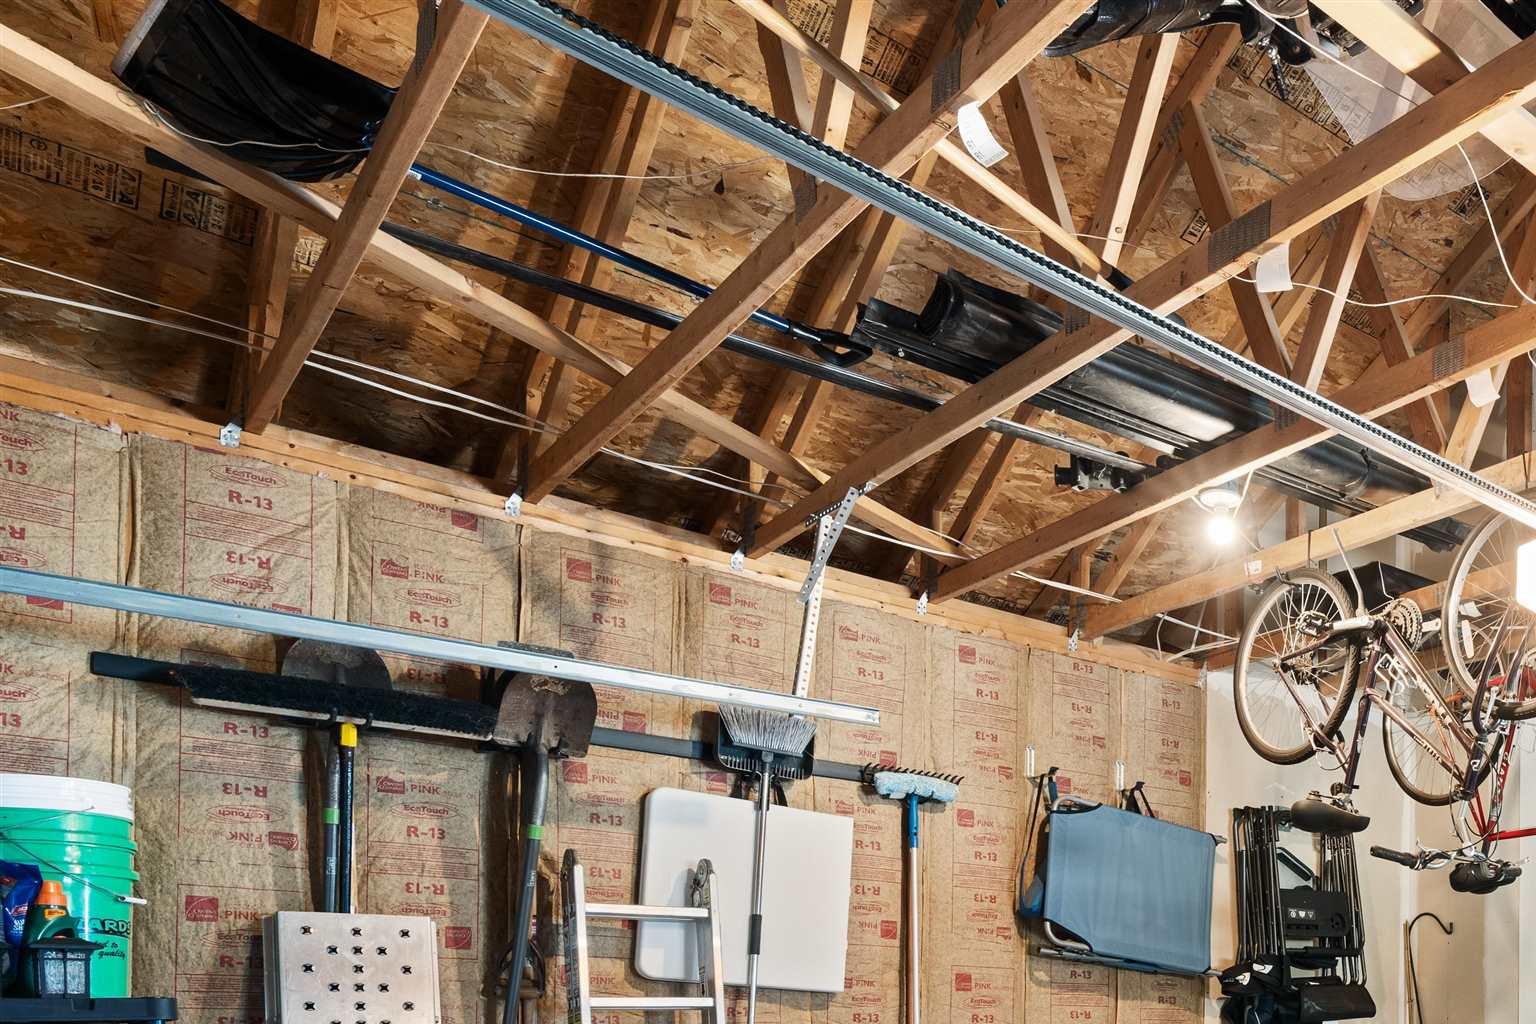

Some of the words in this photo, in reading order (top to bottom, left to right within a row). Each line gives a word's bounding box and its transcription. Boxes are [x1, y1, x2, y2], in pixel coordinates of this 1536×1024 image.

[224, 467, 277, 485] EcoTouch
[228, 489, 273, 511] R-13
[226, 550, 272, 570] R-13
[414, 569, 445, 583] PINK
[595, 574, 623, 587] PINK
[734, 598, 759, 611] PINK
[409, 611, 449, 629] R-13
[592, 611, 626, 629] R-13
[731, 634, 761, 649] R-13
[860, 633, 881, 645] PINK
[857, 667, 884, 681] R-13
[1073, 662, 1094, 675] R-13
[976, 688, 999, 701] R-13
[1072, 702, 1093, 714] R-13
[1162, 698, 1181, 710] R-13
[224, 721, 269, 739] R-13
[975, 730, 999, 743] R-13
[1161, 737, 1180, 749] R-13
[592, 774, 618, 785] PINK
[222, 782, 268, 798] R-13
[411, 783, 441, 796] PINK
[403, 804, 449, 815] EcoTouch
[590, 812, 623, 827] R-13
[406, 825, 446, 841] R-13
[855, 840, 881, 851] R-13
[974, 851, 998, 862] R-13
[589, 866, 622, 880] R-13
[404, 882, 445, 896] R-13
[854, 885, 881, 896] R-13
[973, 893, 997, 905] R-13
[224, 910, 258, 921] PINK
[590, 975, 616, 985] PINK
[1070, 969, 1092, 980] R-13
[1158, 995, 1177, 1006] R-13
[853, 1013, 880, 1024] R-13
[971, 1014, 995, 1024] R-13
[1070, 1010, 1092, 1020] R-13
